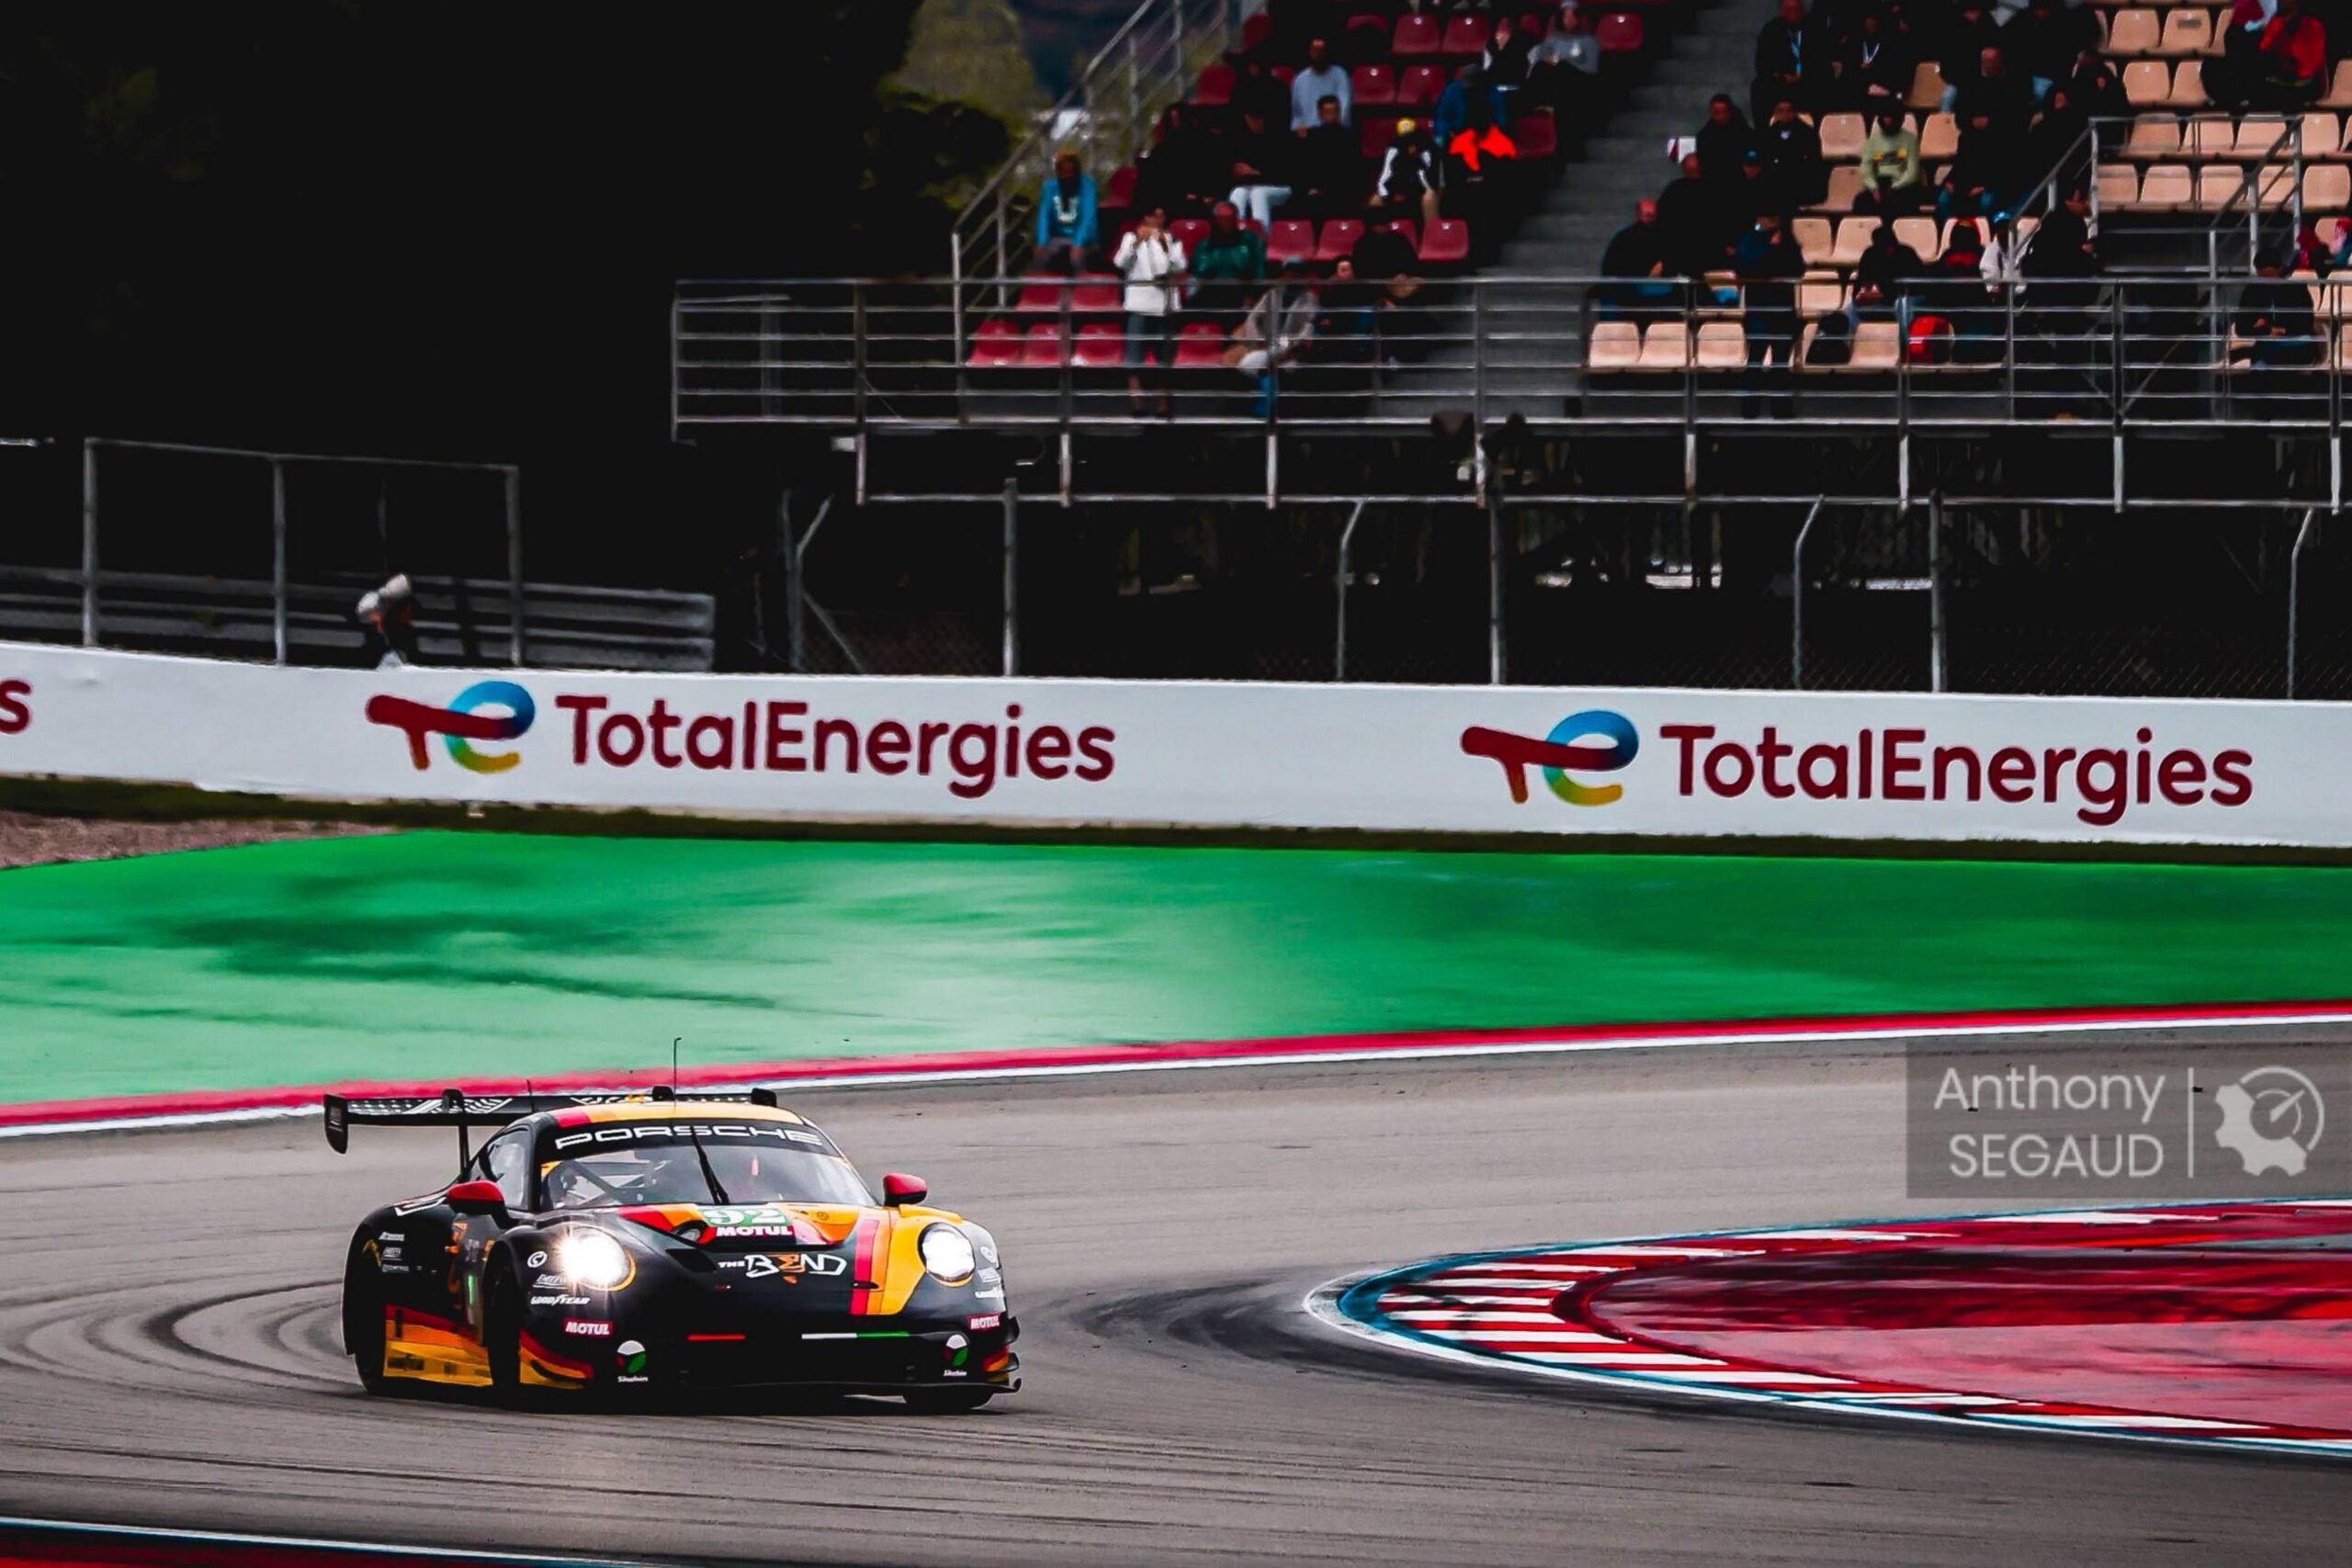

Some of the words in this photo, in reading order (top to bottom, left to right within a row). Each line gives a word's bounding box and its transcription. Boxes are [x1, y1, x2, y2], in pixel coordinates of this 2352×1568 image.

[556, 694, 1116, 799] TotalEnergies
[1659, 726, 2255, 826] TotalEnergies
[555, 1125, 823, 1149] PORSCHE
[703, 1208, 786, 1225] 92
[716, 1225, 793, 1237] MOTUL
[565, 1321, 610, 1336] MOTUL
